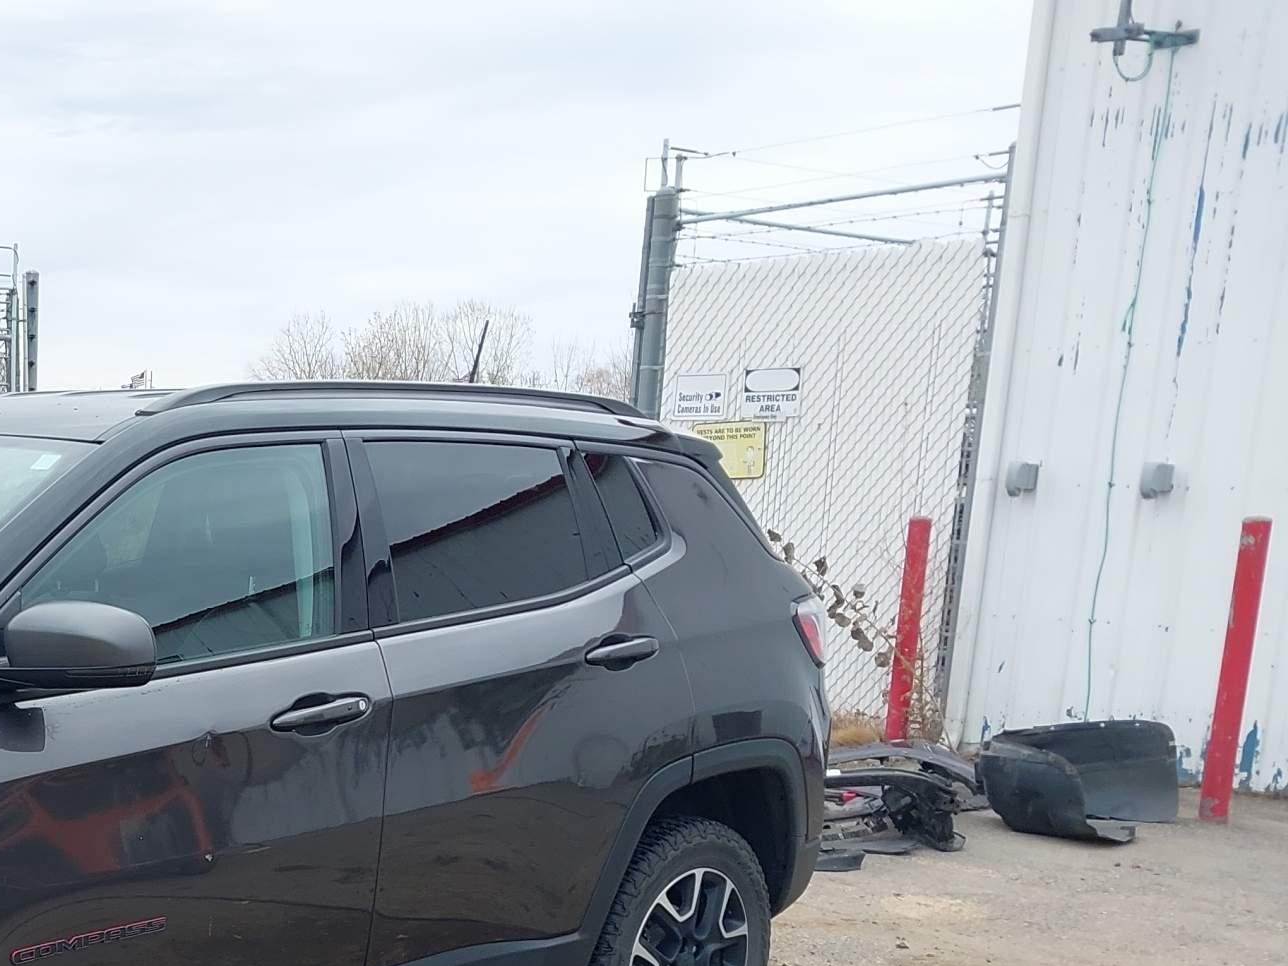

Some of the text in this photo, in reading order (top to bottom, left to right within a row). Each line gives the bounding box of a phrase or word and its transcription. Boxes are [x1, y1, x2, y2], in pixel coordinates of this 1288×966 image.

[678, 392, 704, 403] Security
[745, 393, 797, 403] RESTRICTED
[677, 404, 721, 414] Cameras In Use
[759, 404, 782, 413] AREA
